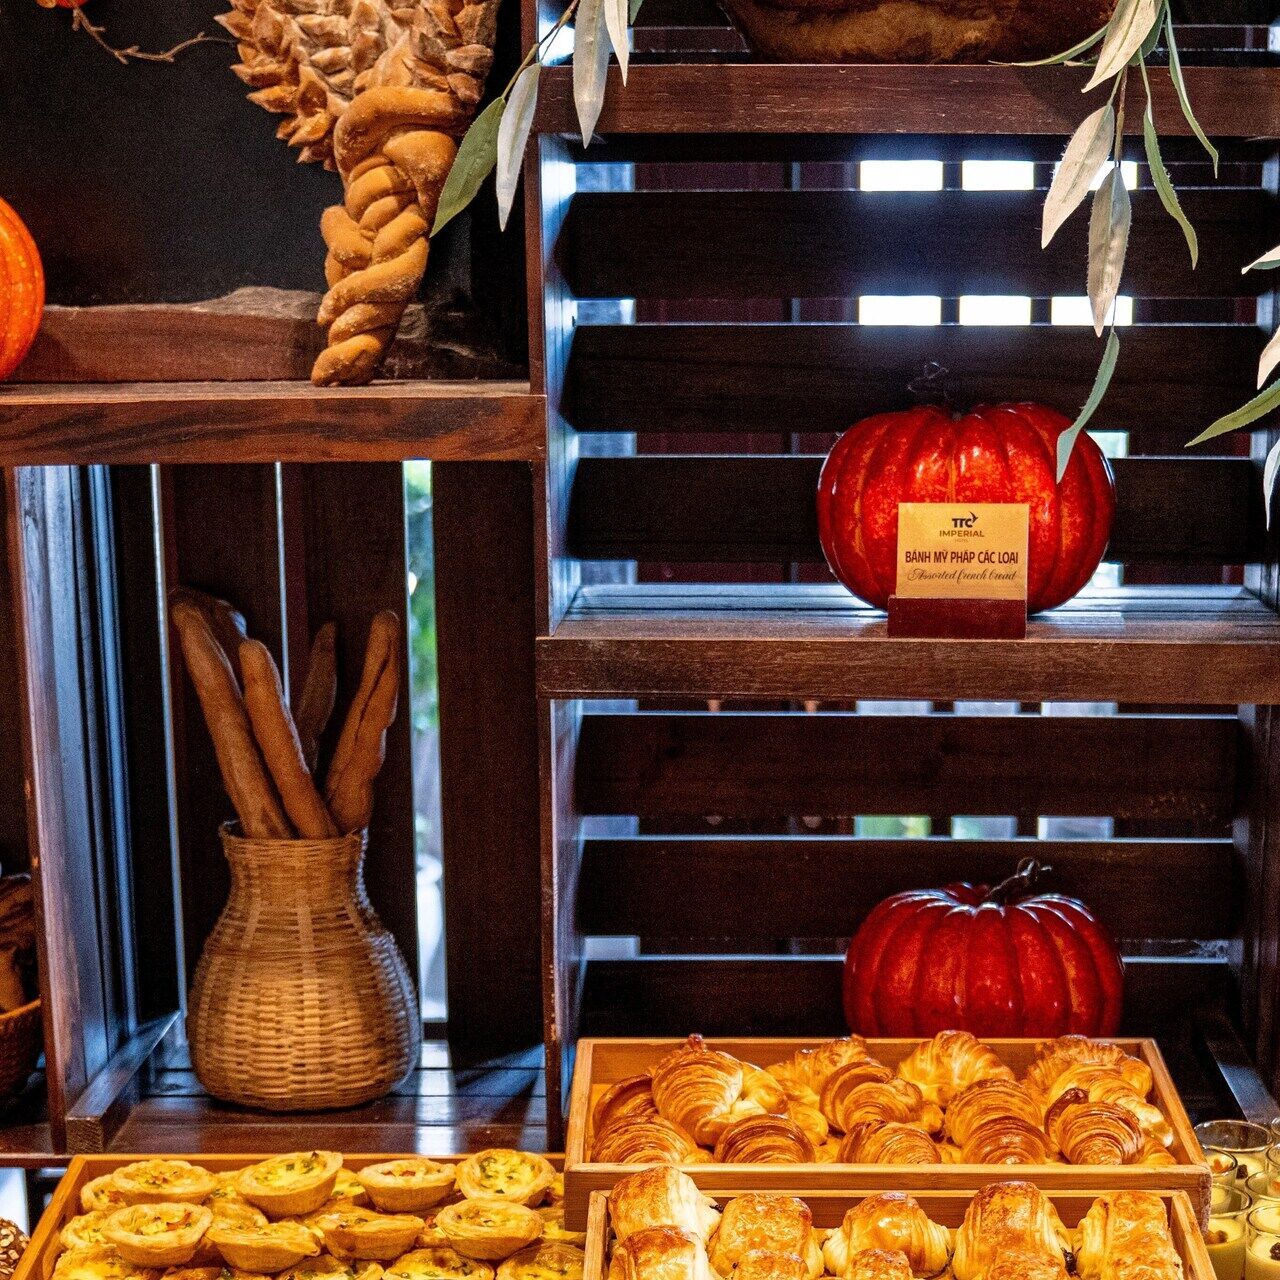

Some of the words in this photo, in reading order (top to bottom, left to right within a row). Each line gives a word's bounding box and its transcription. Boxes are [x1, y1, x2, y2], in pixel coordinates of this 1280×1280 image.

[951, 517, 974, 528] TTC
[905, 549, 931, 563] BÁNH
[950, 550, 975, 563] PHÁP
[977, 549, 996, 564] CÁC
[907, 568, 956, 581] Assorted
